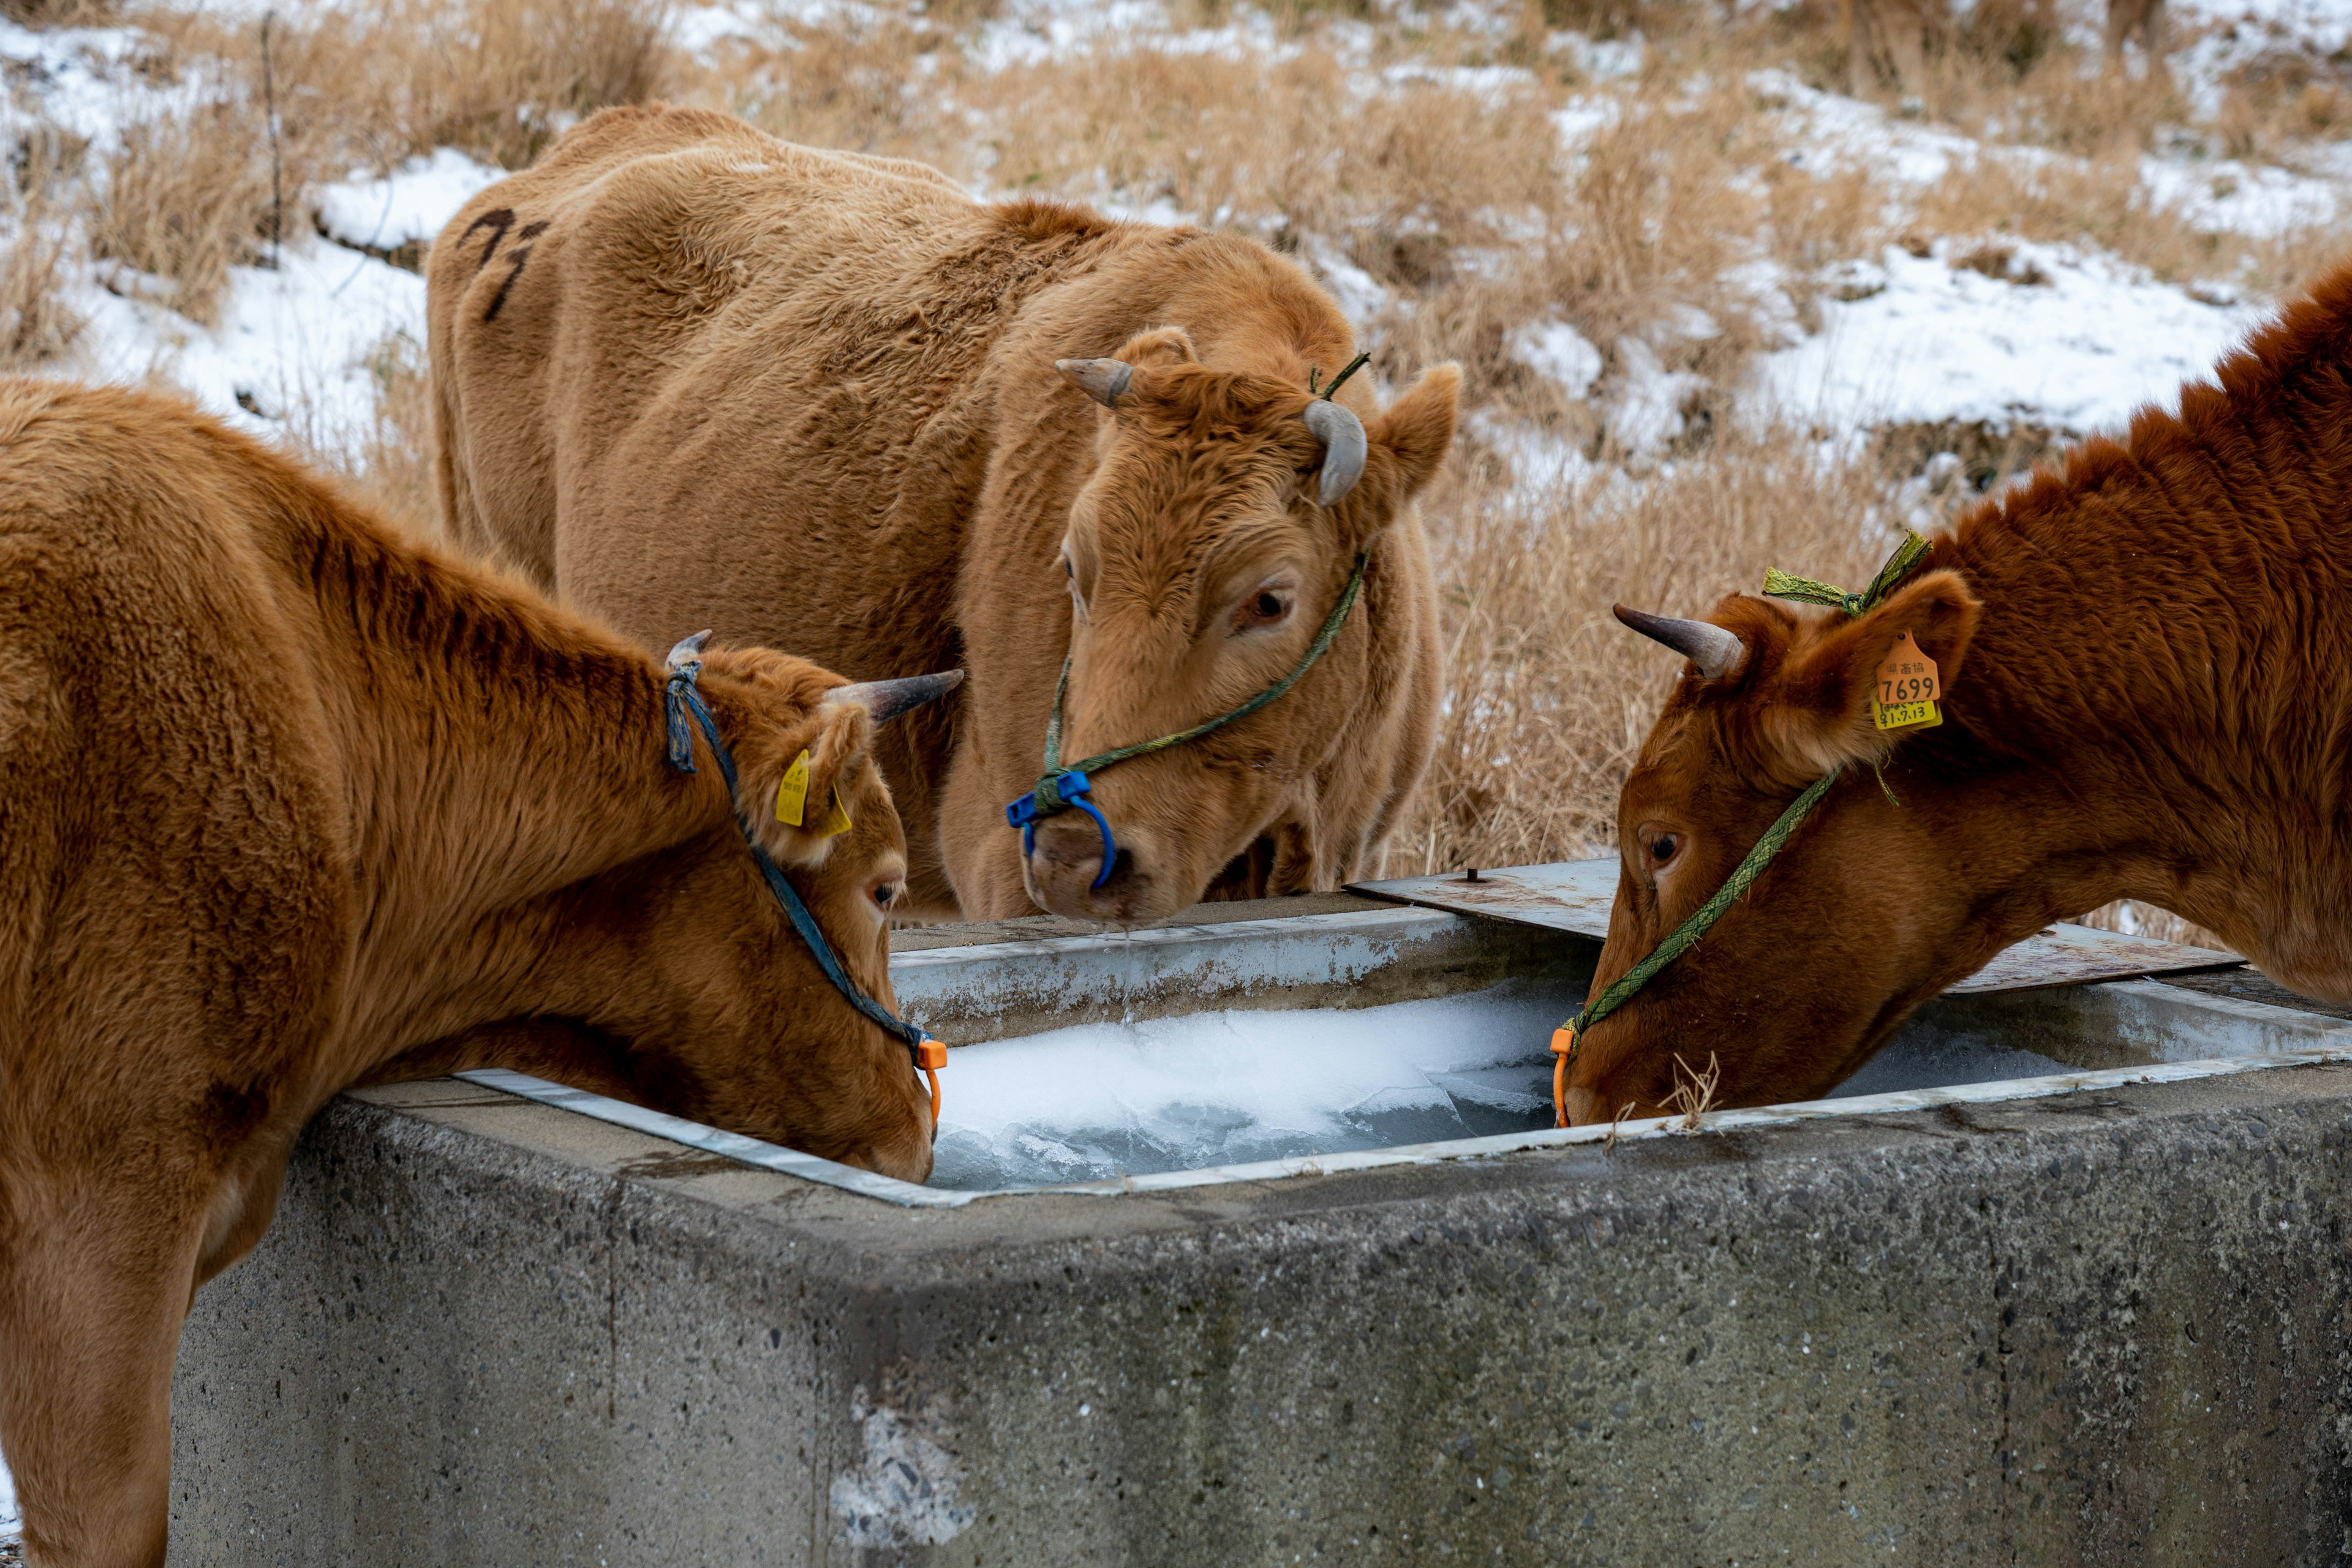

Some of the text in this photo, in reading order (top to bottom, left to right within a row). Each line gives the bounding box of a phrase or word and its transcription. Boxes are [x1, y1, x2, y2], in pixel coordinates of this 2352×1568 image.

[1887, 662, 1924, 675] 県畜協
[1882, 677, 1933, 702] 7699
